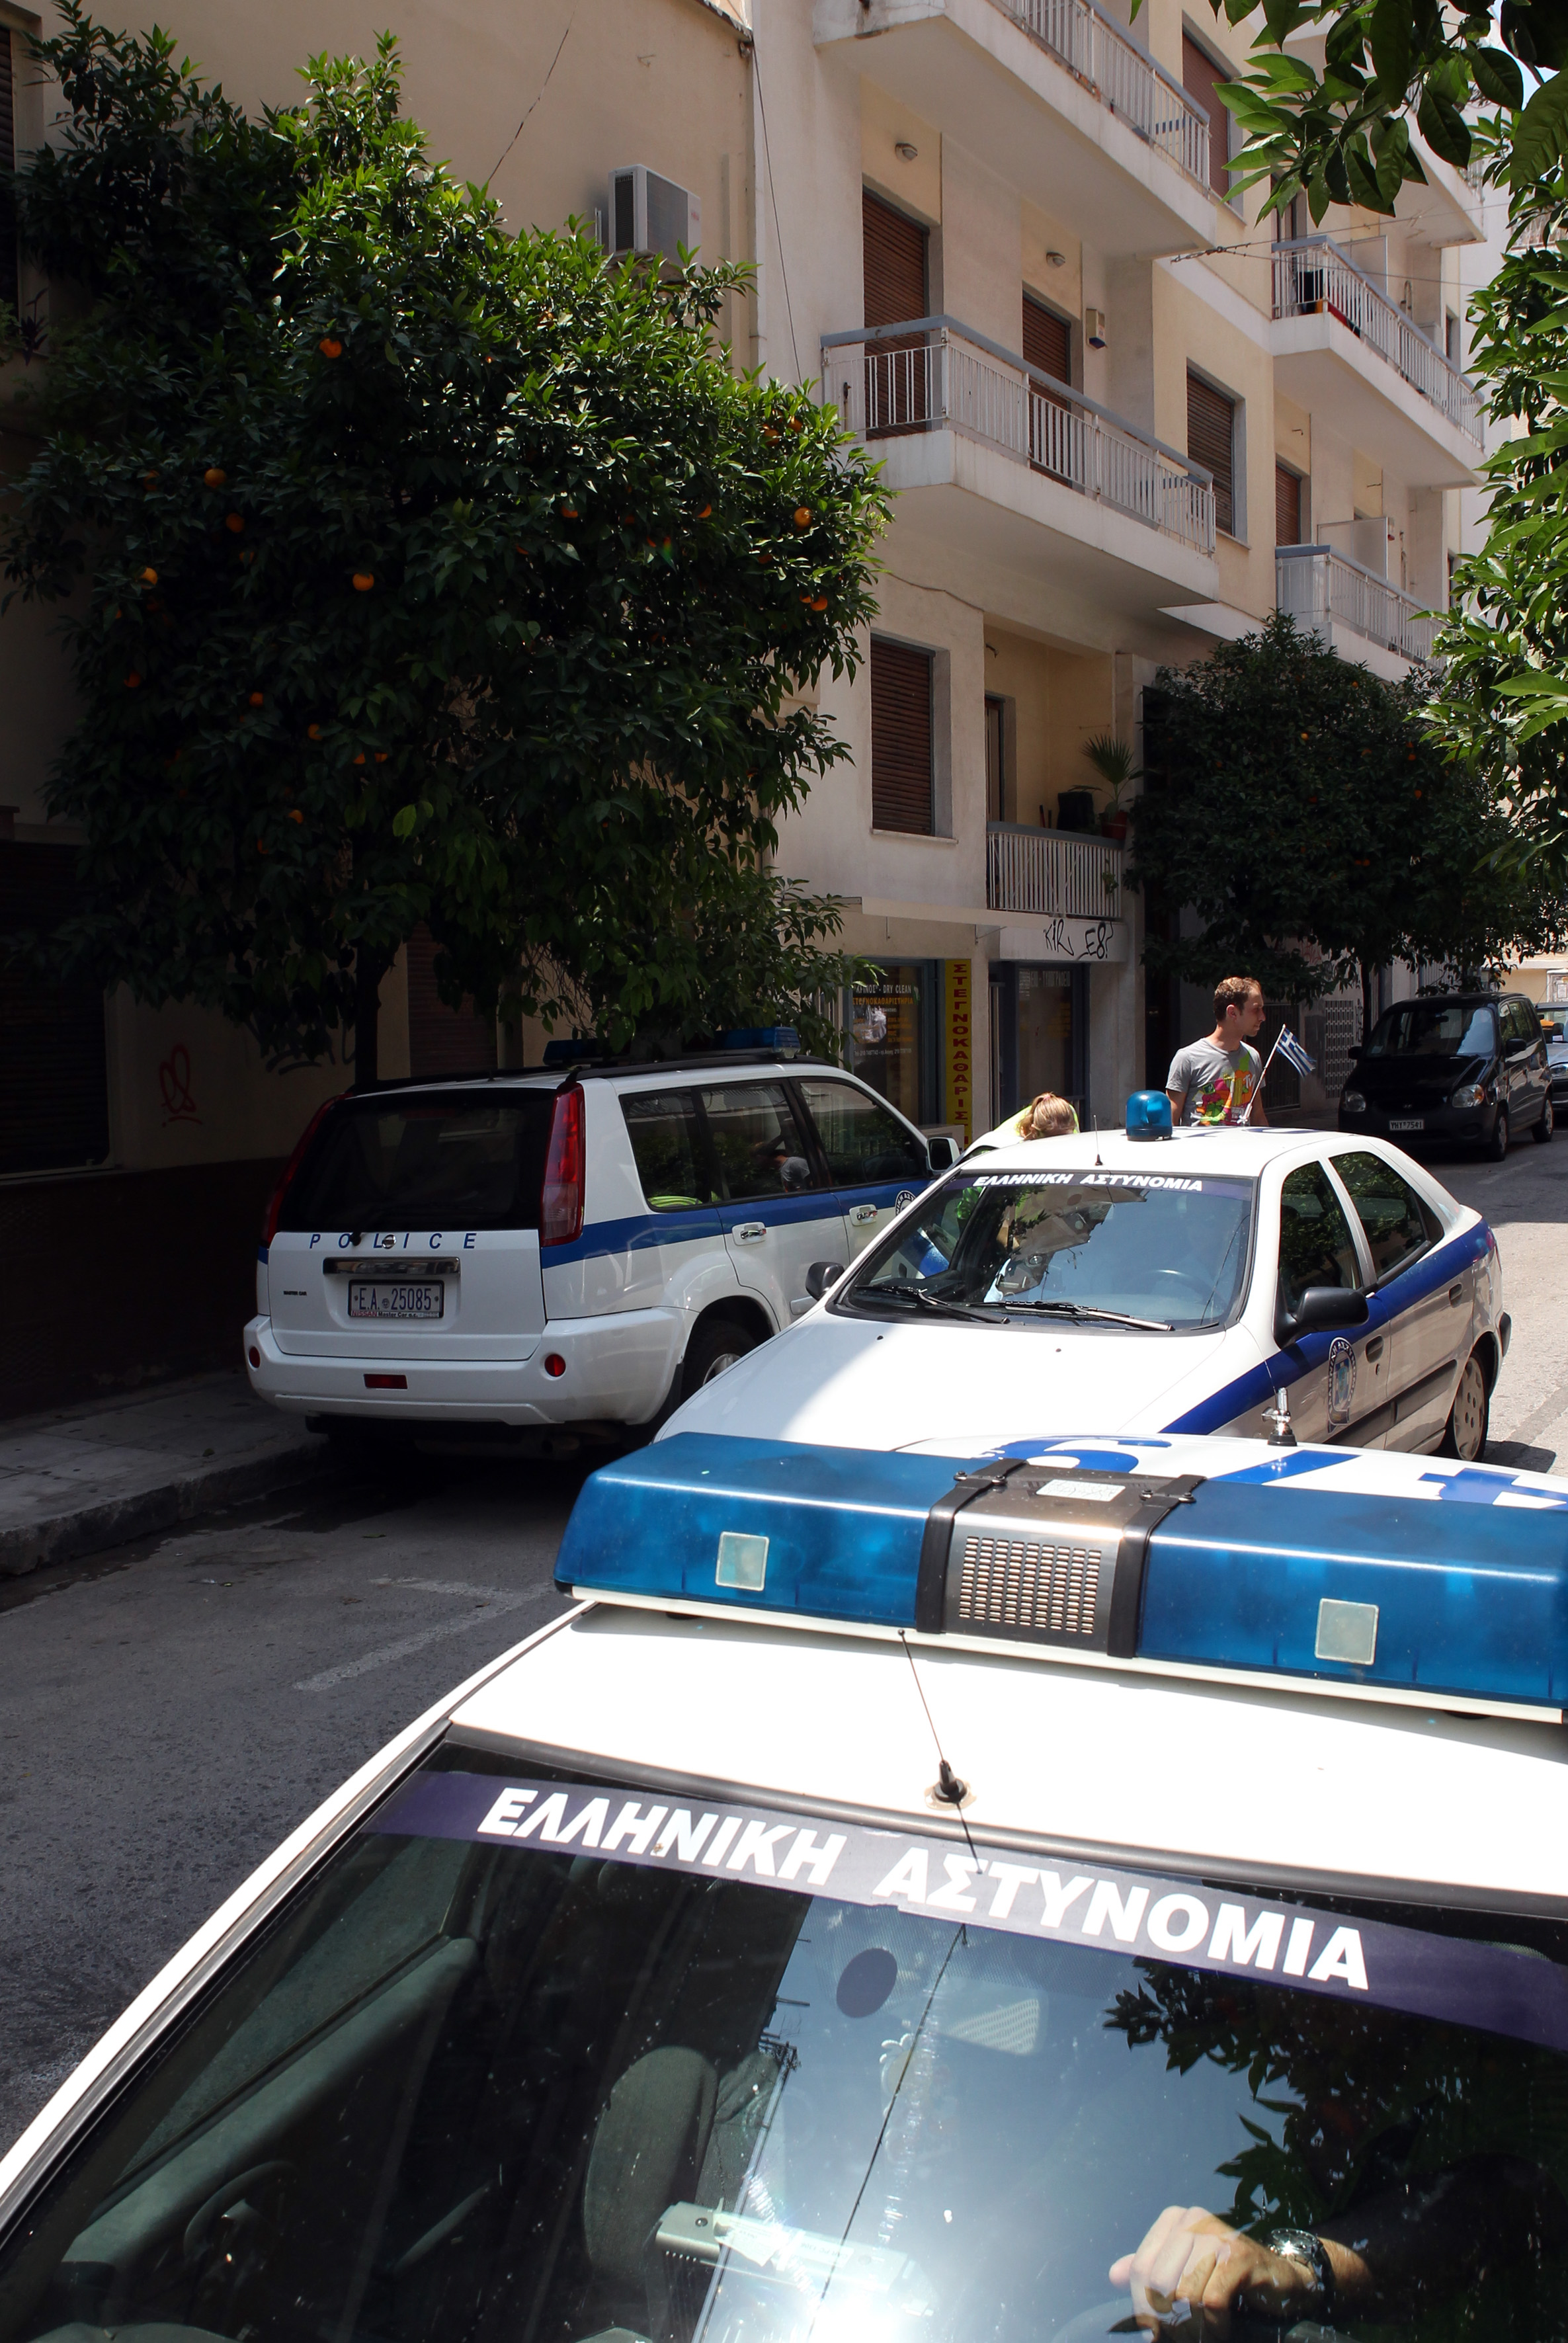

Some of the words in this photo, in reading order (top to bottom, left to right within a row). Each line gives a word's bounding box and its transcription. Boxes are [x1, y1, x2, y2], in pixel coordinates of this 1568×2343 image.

[883, 984, 893, 994] DRY
[895, 984, 912, 994] CLEAN
[972, 1174, 1075, 1186] ΕΛΛΗΝΙΚΗ
[1079, 1174, 1203, 1192] ΑΣΤΥΝΟΜΙΑ
[309, 1233, 477, 1249] POLICE
[391, 1288, 432, 1311] 25085
[477, 1787, 847, 1886] ΕΛΛΗΝΙΚΗ
[872, 1847, 1369, 1991] ΑΣΤΥΝΟΜΙΑ
